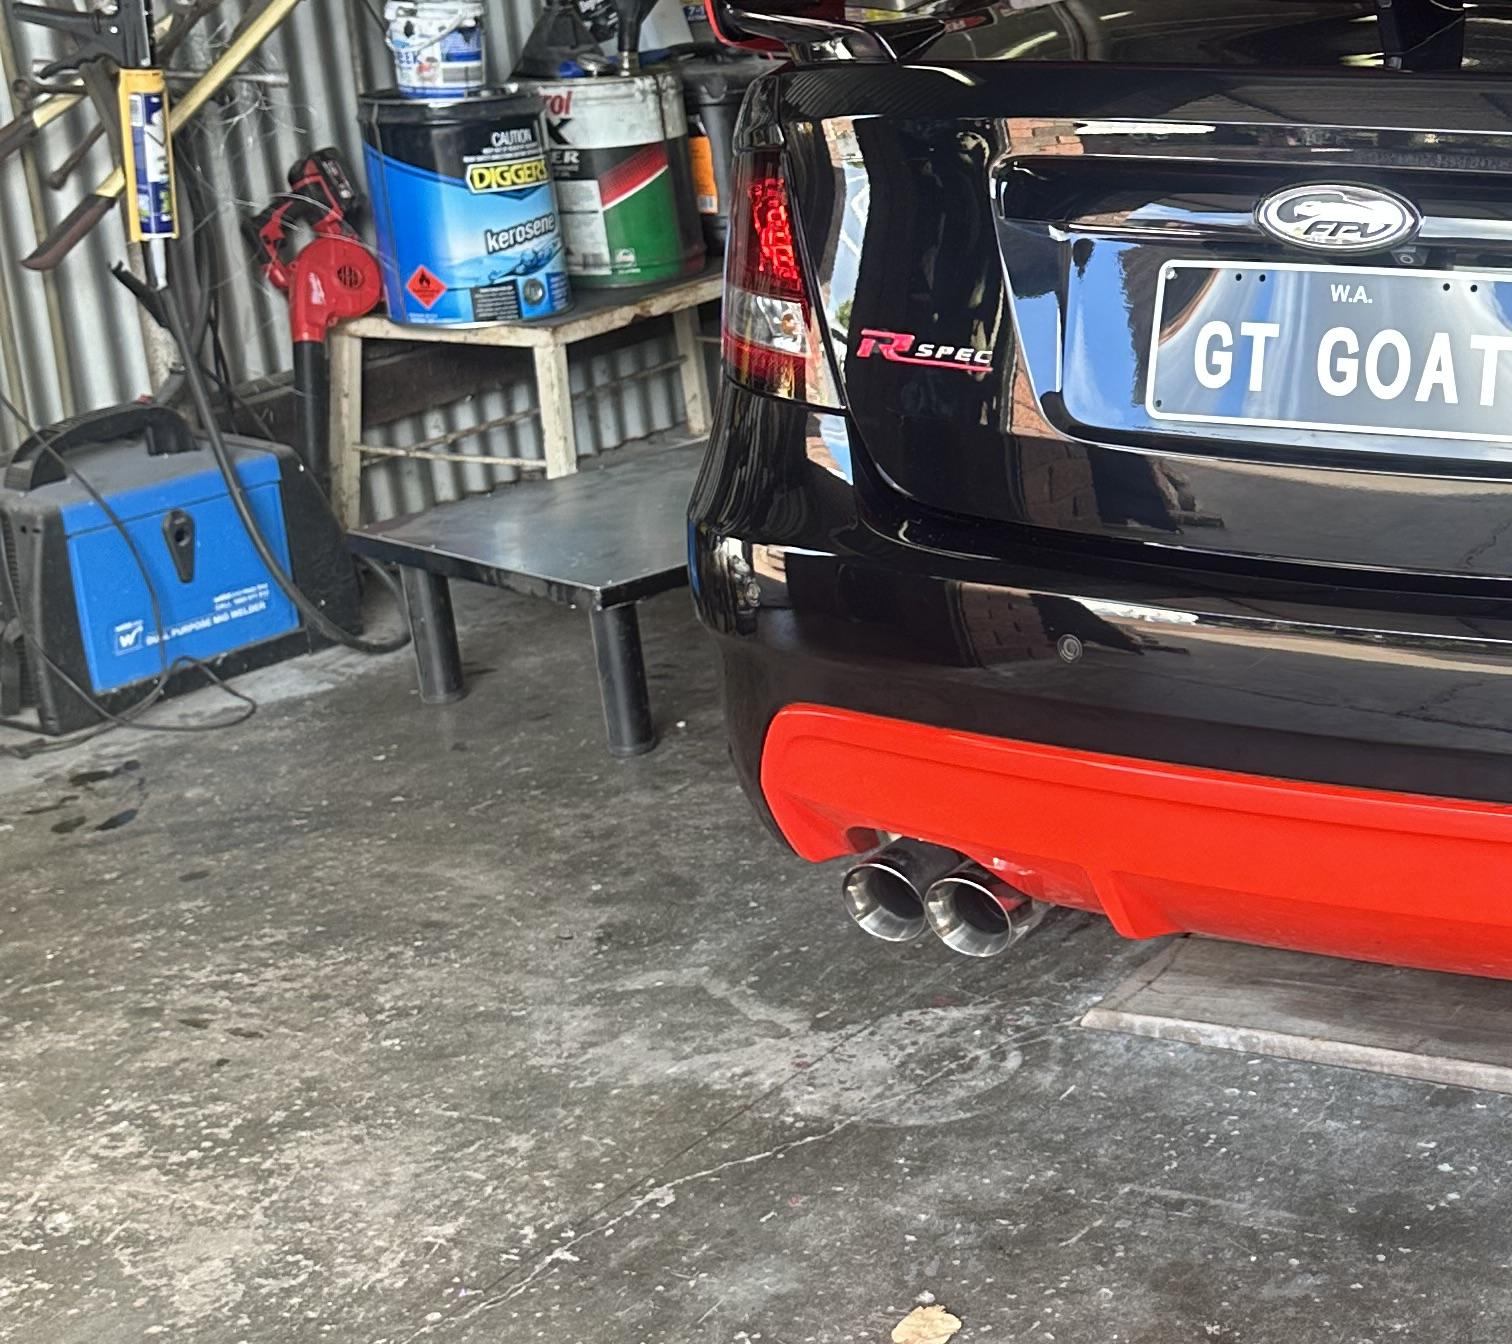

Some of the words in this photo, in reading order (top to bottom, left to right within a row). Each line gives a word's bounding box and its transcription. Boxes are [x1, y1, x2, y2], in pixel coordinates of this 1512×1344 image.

[491, 127, 533, 147] CAUTION
[486, 214, 555, 254] kerosene
[1303, 220, 1394, 239] FPV
[1330, 283, 1373, 304] W.A.
[914, 343, 993, 364] SPEC
[1193, 320, 1280, 393] GT
[146, 631, 170, 646] DUL
[213, 611, 230, 625] MIG
[230, 601, 266, 620] WELDER
